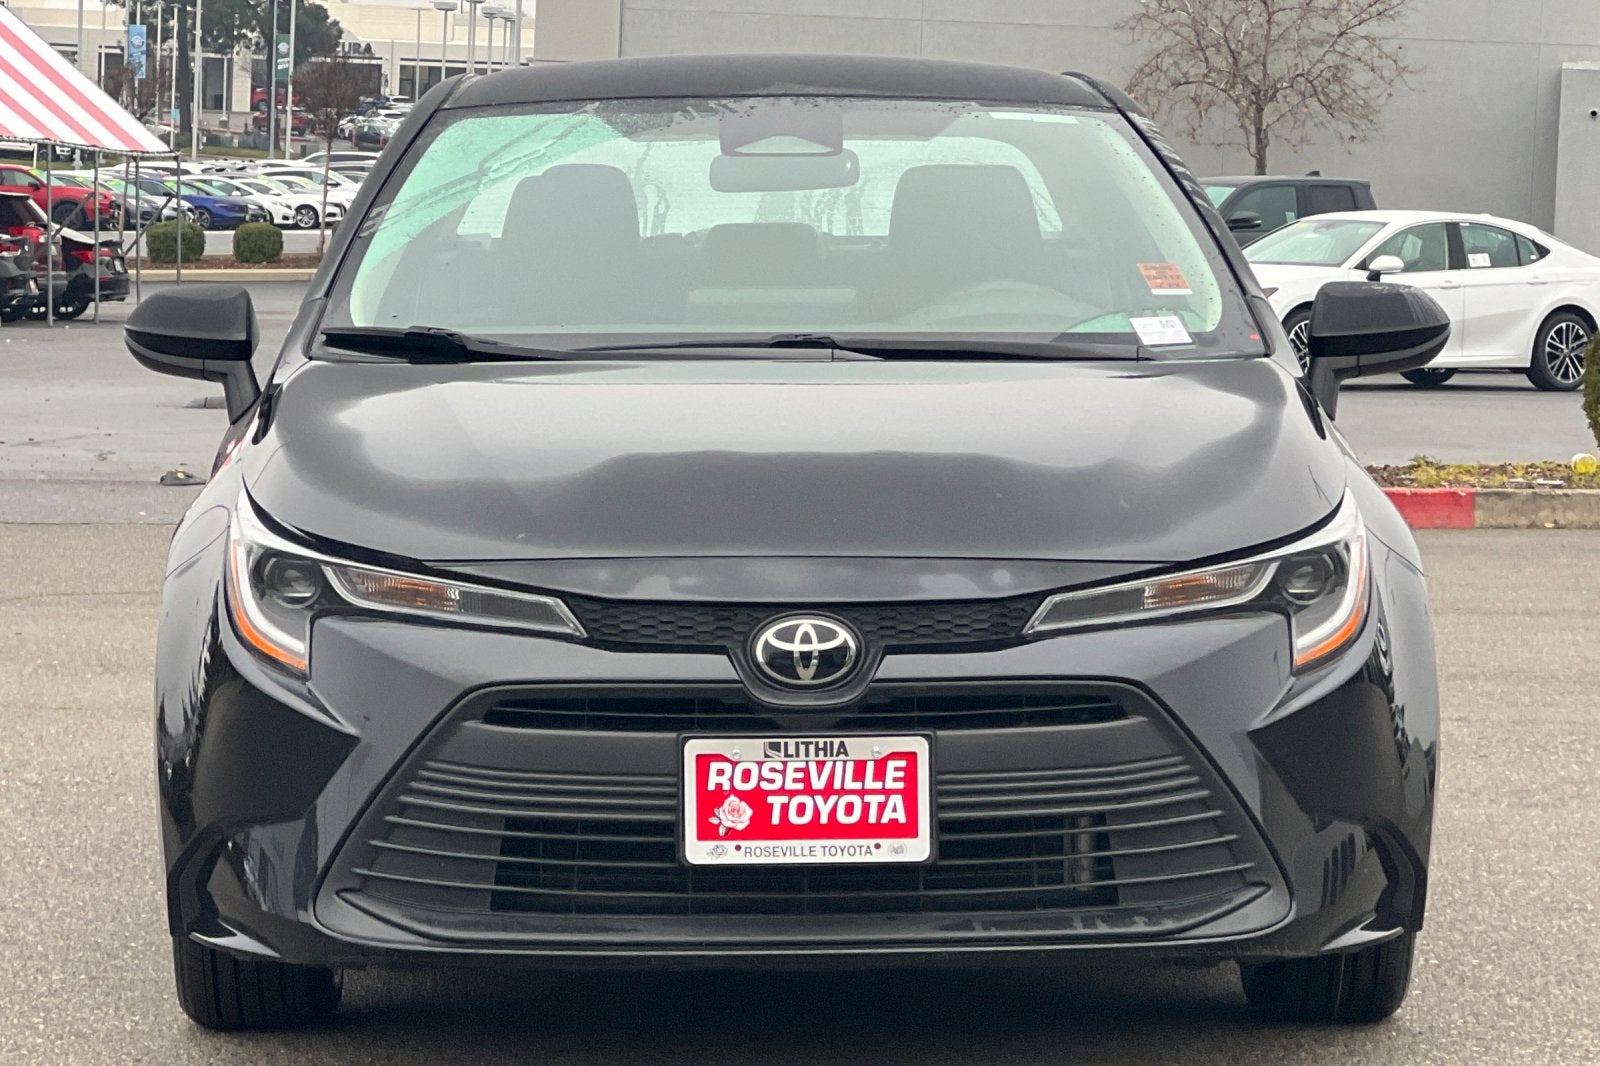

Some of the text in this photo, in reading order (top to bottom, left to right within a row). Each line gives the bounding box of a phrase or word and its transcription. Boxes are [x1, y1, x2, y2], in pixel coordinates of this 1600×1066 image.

[782, 740, 849, 758] LITHIA
[707, 759, 907, 792] ROSEVILLE
[766, 793, 907, 825] TOYOTA
[744, 844, 873, 858] ROSEVILLE TOYOTA
